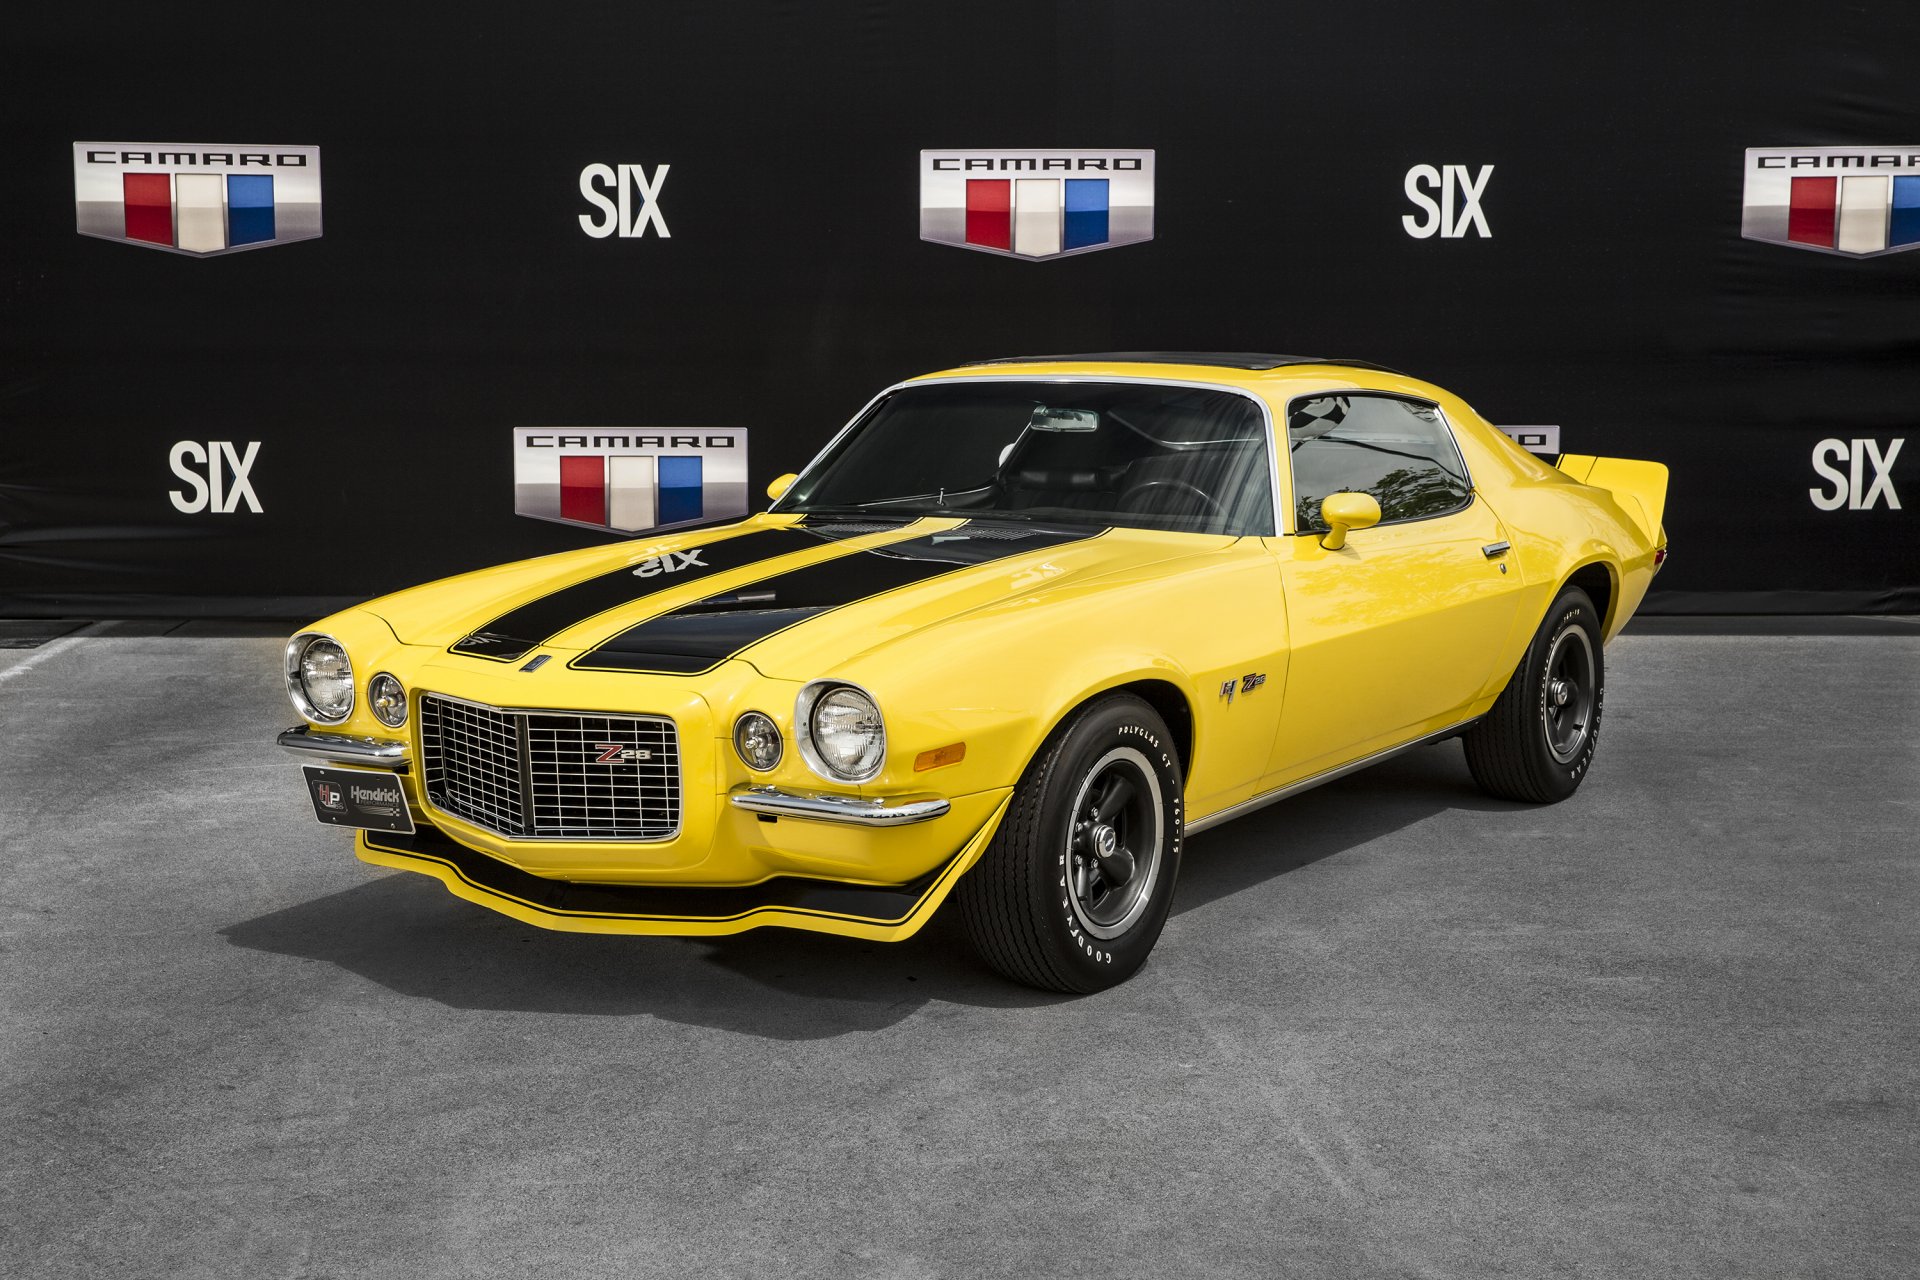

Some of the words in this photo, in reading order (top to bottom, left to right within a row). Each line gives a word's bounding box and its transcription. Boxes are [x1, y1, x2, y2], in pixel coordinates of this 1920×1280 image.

[86, 151, 307, 167] CAMARO
[932, 158, 1142, 171] CAMARO
[578, 162, 672, 239] SIX
[1401, 163, 1495, 239] SIX
[526, 435, 735, 448] CAMARO
[168, 440, 264, 514] SIX
[1809, 438, 1905, 511] SIX
[1118, 725, 1159, 748] POLYGLAS
[595, 744, 652, 763] Z28
[350, 785, 400, 803] Hendrick
[1059, 854, 1112, 964] GOODYEAR
